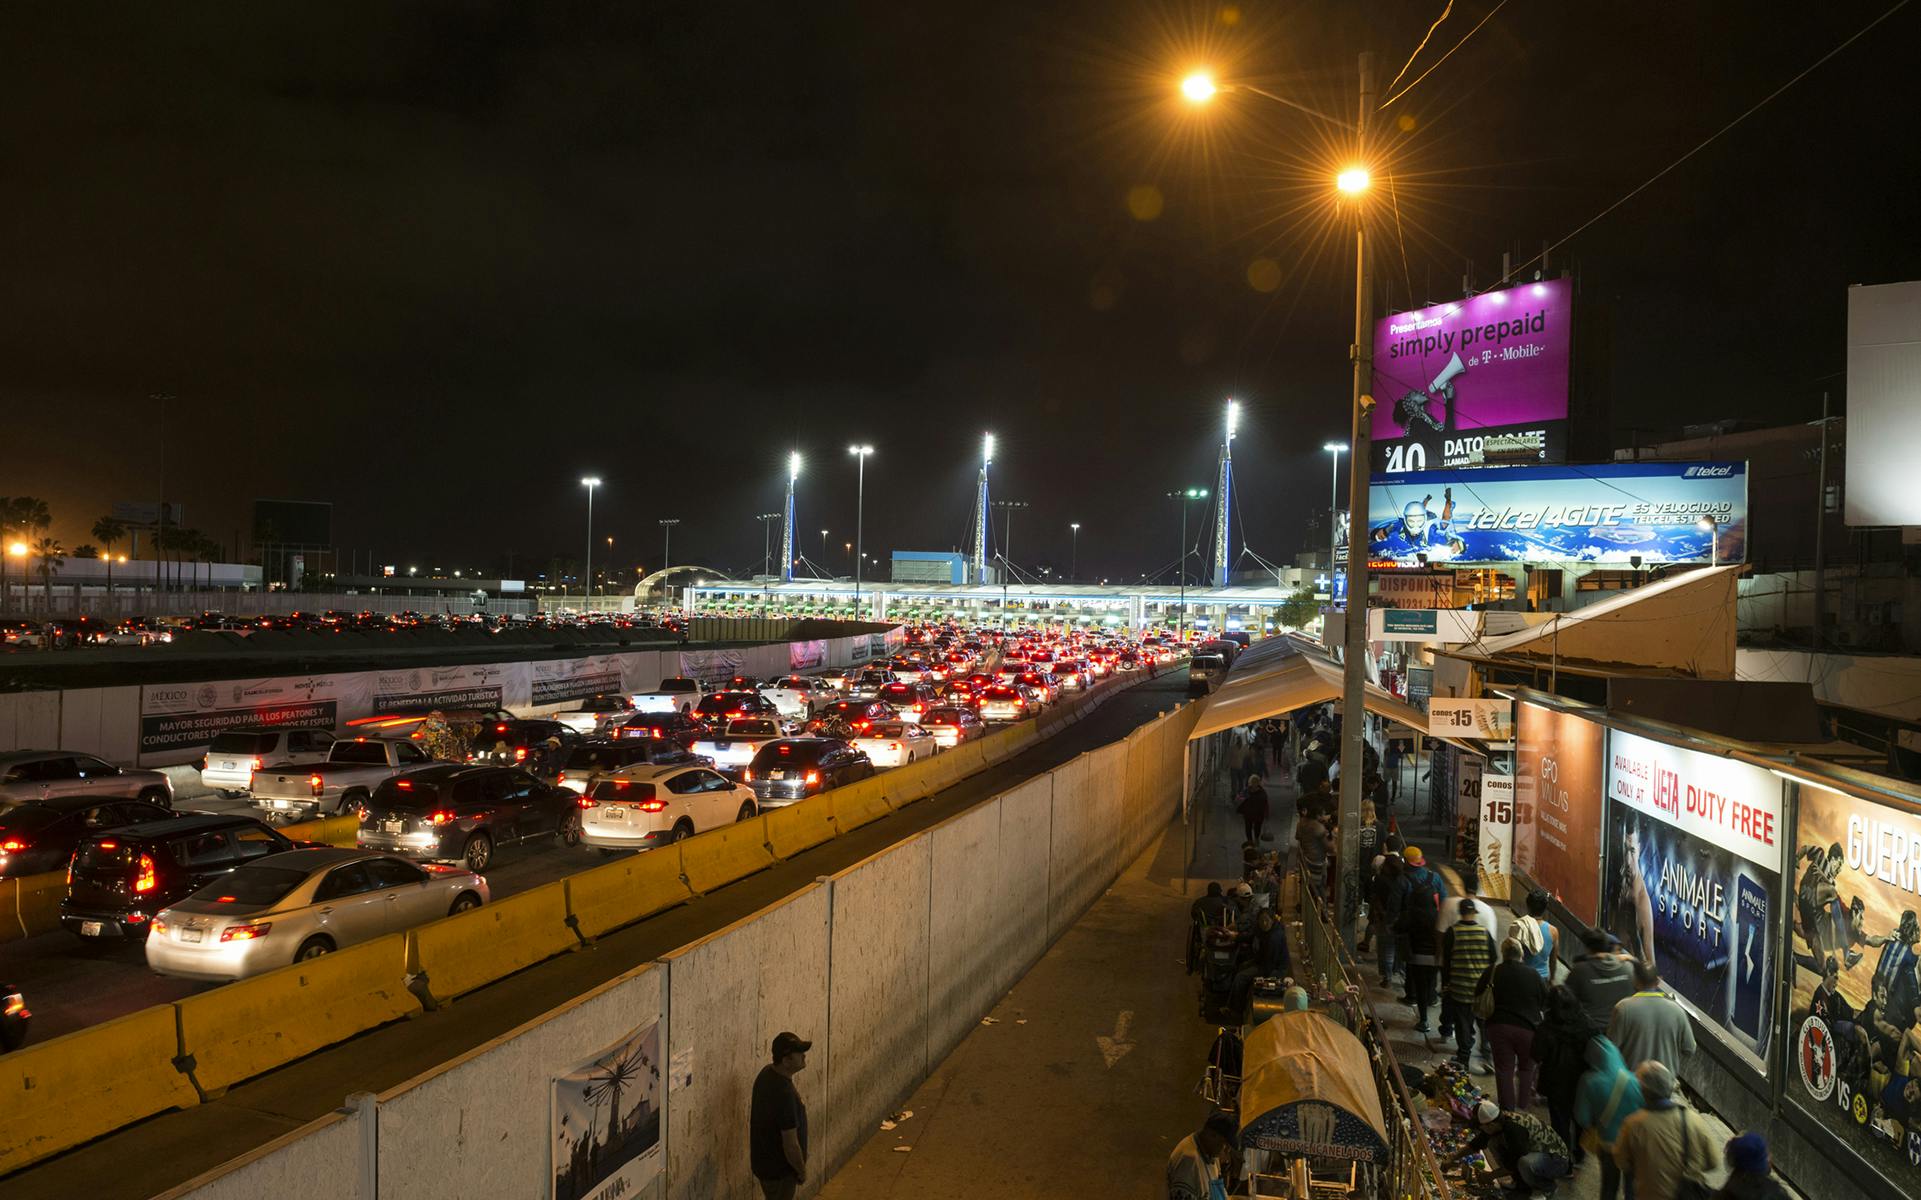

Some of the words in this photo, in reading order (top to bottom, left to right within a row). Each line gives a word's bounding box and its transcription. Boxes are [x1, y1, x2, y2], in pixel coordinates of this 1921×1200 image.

[1390, 329, 1456, 358] simply
[1461, 310, 1544, 350] prepaid
[1469, 356, 1478, 366] de
[1385, 442, 1426, 473] $40
[1697, 465, 1732, 477] telcel
[1467, 504, 1551, 530] telcel
[1632, 503, 1649, 514] ES
[1654, 501, 1732, 514] VELOCIDAD
[1632, 515, 1672, 525] TELCEL
[1673, 515, 1688, 524] ES
[150, 690, 187, 702] MÉXICO
[434, 694, 467, 705] ACTIVIDAD
[468, 690, 498, 701] TURÍSTICA
[159, 720, 193, 732] MAYOR
[194, 715, 242, 728] SEGURIDAD
[243, 714, 264, 723] PARA
[265, 711, 280, 721] LOS
[281, 708, 317, 719] PEATONES
[318, 707, 324, 715] Y
[1450, 709, 1472, 726] $15
[143, 731, 208, 745] CONDUCTORES
[1541, 757, 1558, 783] GPO
[1614, 755, 1648, 780] AVAILABLE
[1487, 780, 1512, 790] conos
[1617, 779, 1633, 801] ONLY
[1635, 789, 1645, 804] AT
[1483, 800, 1511, 825] $15
[1653, 760, 1679, 820] UETA
[1687, 784, 1726, 825] DUTY
[1732, 800, 1774, 847] FREE
[1660, 857, 1723, 922] ANIMALE
[1741, 888, 1766, 913] ANIMALE
[1659, 894, 1721, 947] SPORT
[1836, 1077, 1850, 1111] VS
[1257, 1136, 1302, 1153] CHURROS
[1303, 1143, 1374, 1161] ENCANELADOS
